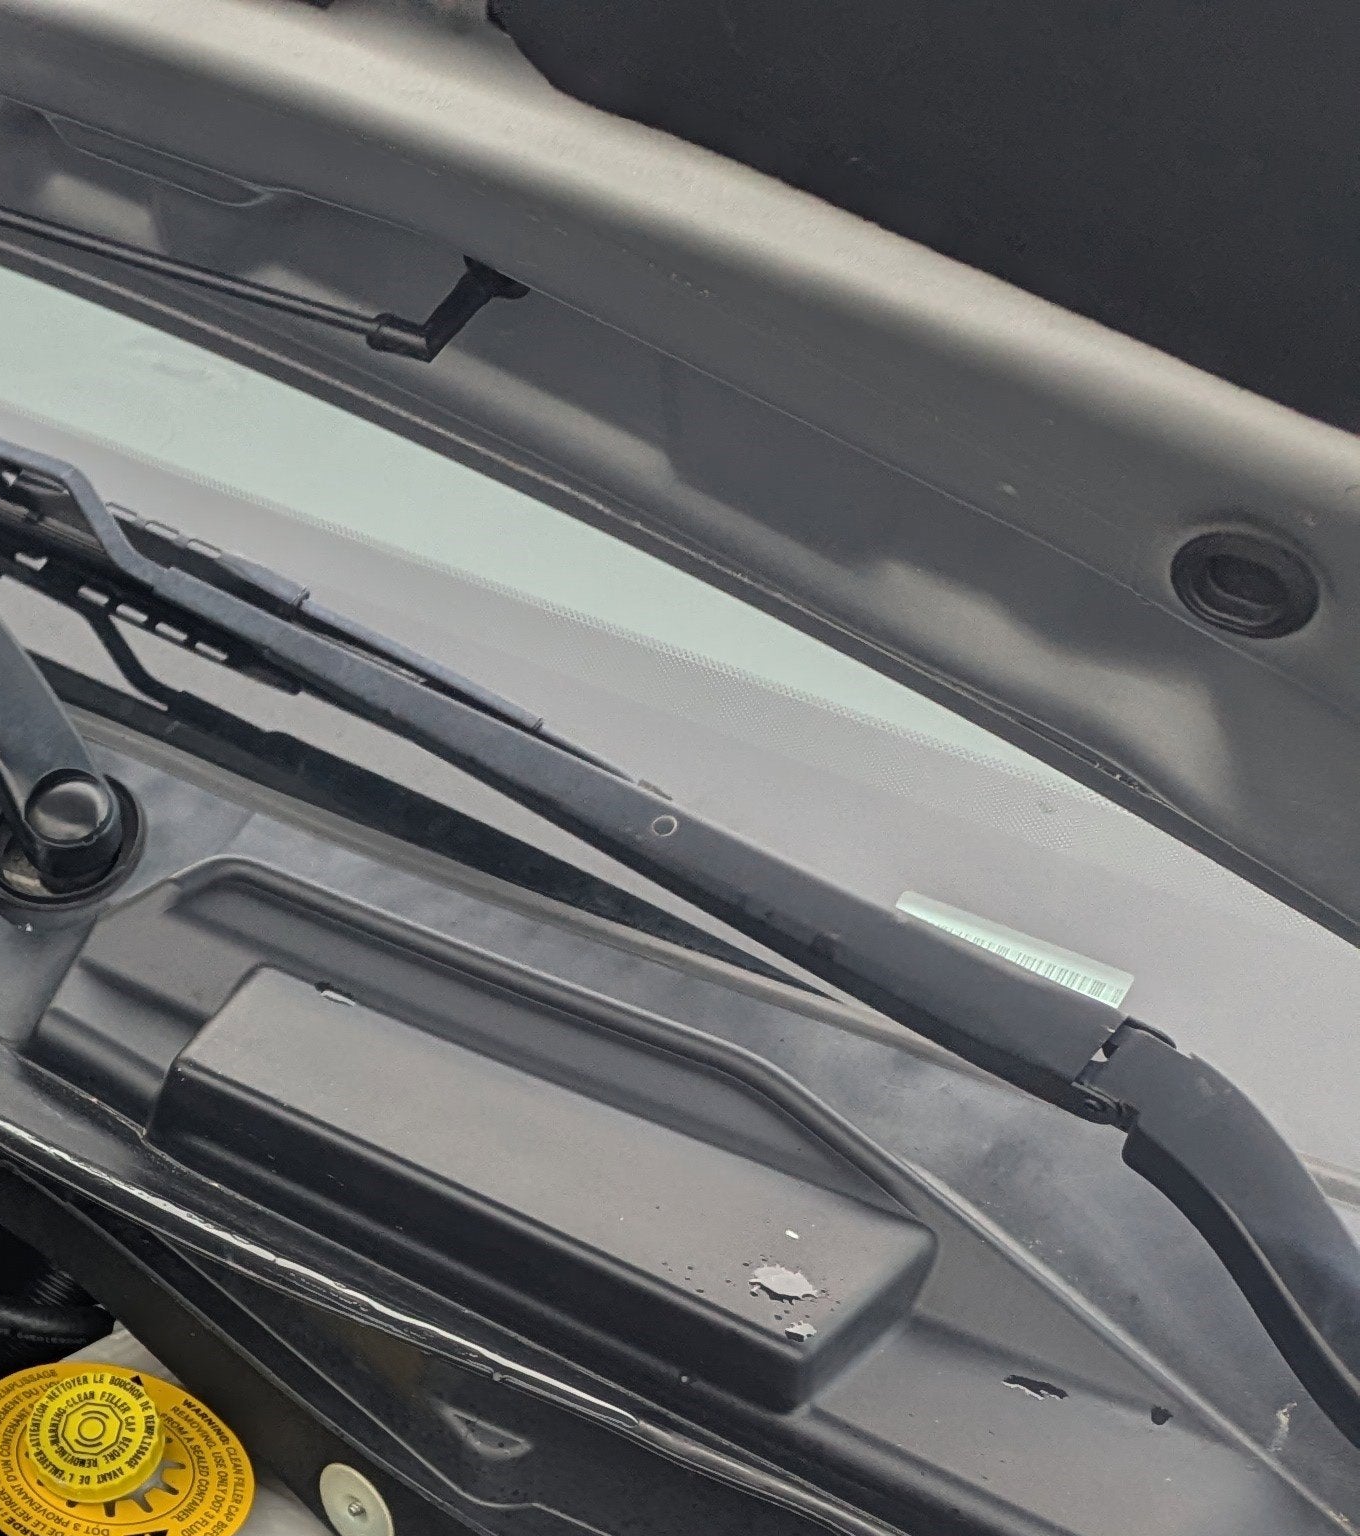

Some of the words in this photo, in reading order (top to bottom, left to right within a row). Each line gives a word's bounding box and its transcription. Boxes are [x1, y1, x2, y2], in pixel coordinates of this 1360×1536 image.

[93, 1374, 104, 1383] LE
[22, 1388, 39, 1399] DU
[0, 1407, 30, 1457] CONTENANT
[79, 1475, 90, 1484] DE
[11, 1484, 70, 1527] PROVENANT
[170, 1479, 209, 1521] CONTAINER
[210, 1495, 225, 1513] DOT
[31, 1520, 47, 1531] LE
[73, 1523, 81, 1531] 3
[181, 1517, 209, 1536] FLUID
[84, 1527, 109, 1536] DOT
